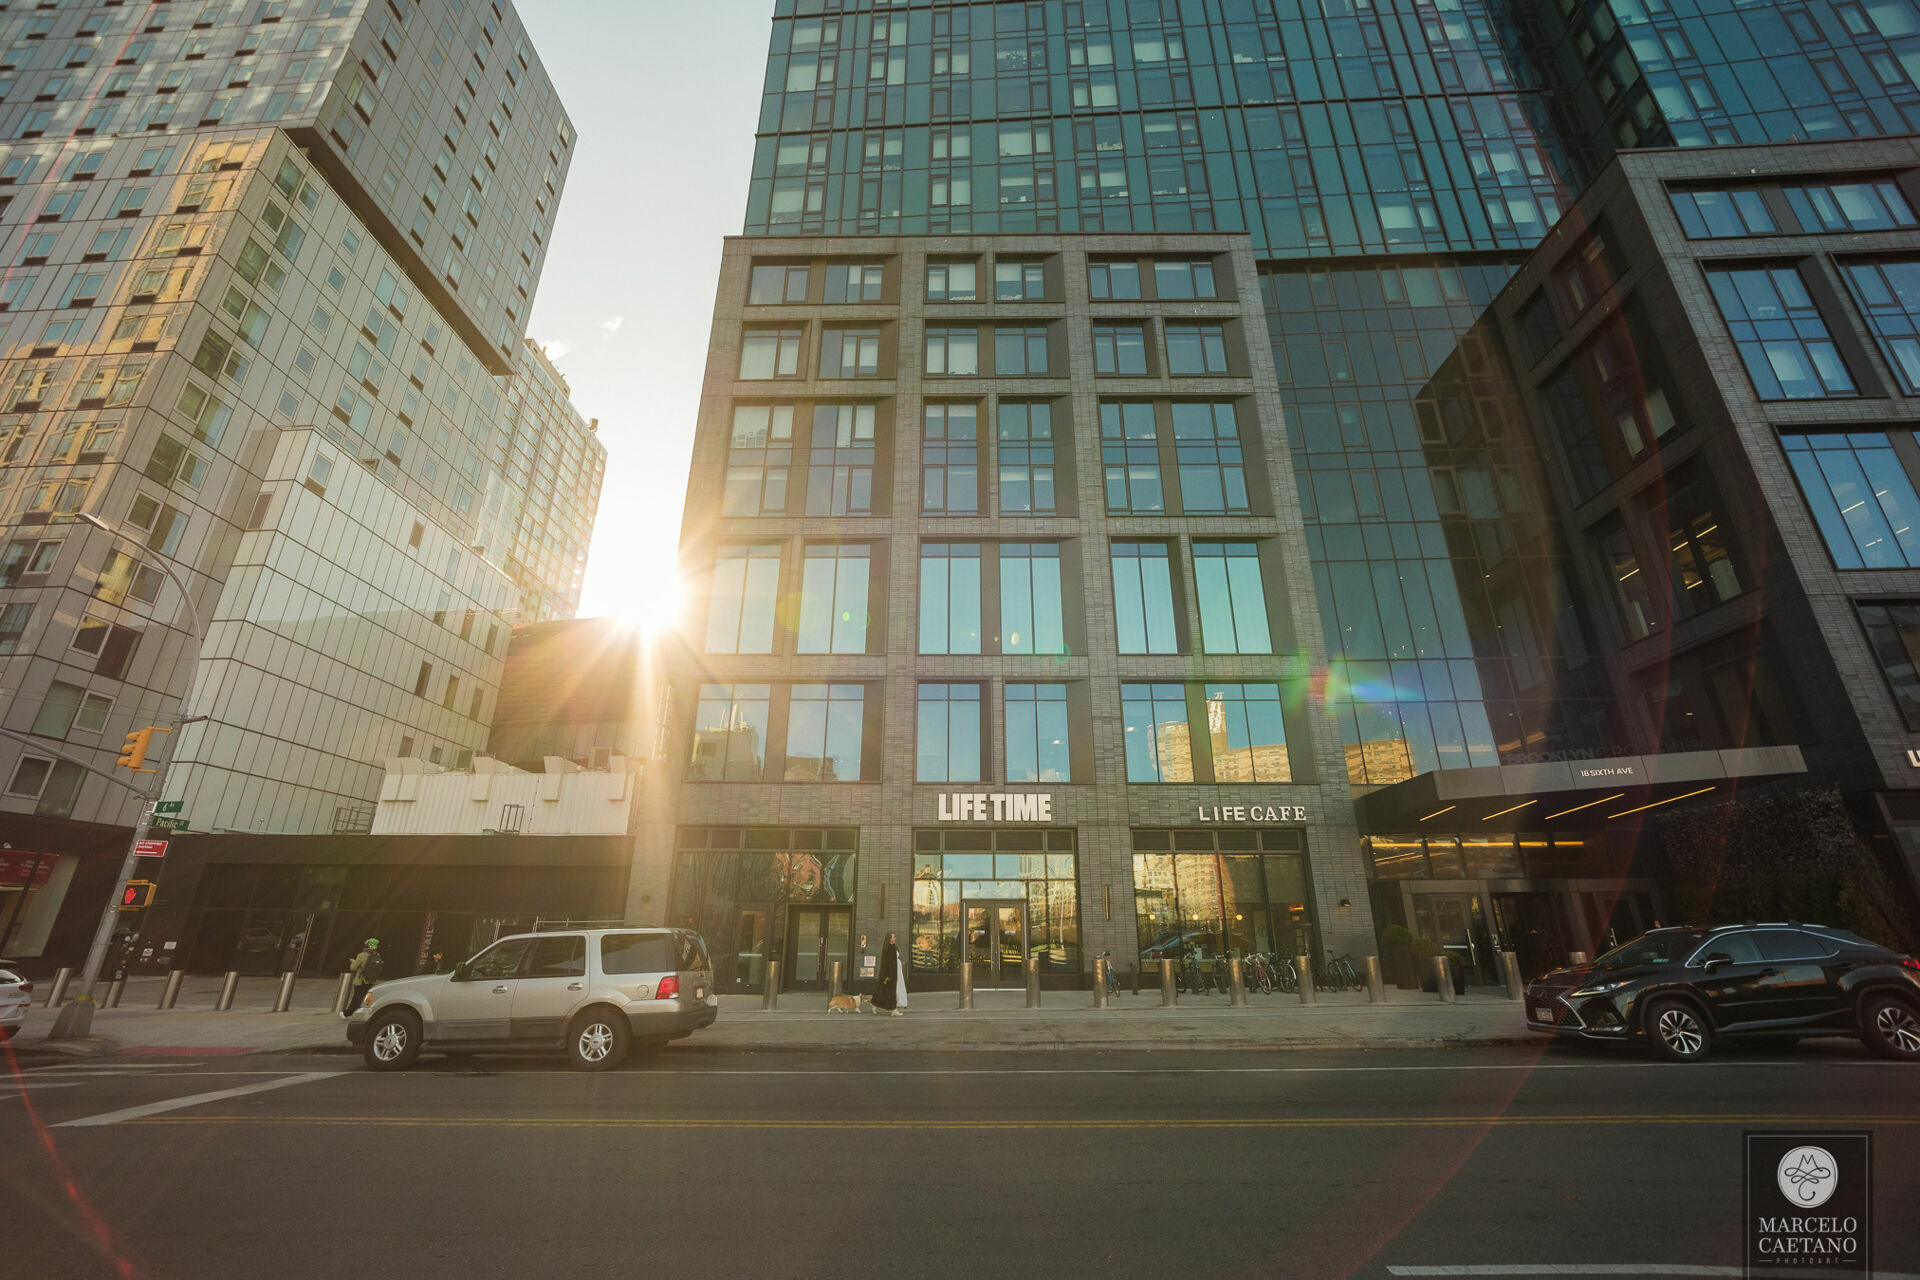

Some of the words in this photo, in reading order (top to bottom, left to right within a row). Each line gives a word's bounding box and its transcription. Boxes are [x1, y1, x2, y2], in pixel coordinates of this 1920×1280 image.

[1580, 769, 1590, 777] 18
[1590, 768, 1615, 777] SIXTH
[1616, 767, 1635, 775] AVE
[162, 803, 168, 811] 6
[938, 793, 987, 821] LIFE
[989, 793, 1052, 822] TIME
[1199, 806, 1246, 821] LIFE
[1250, 806, 1307, 821] CAFE
[155, 818, 178, 829] Pacific
